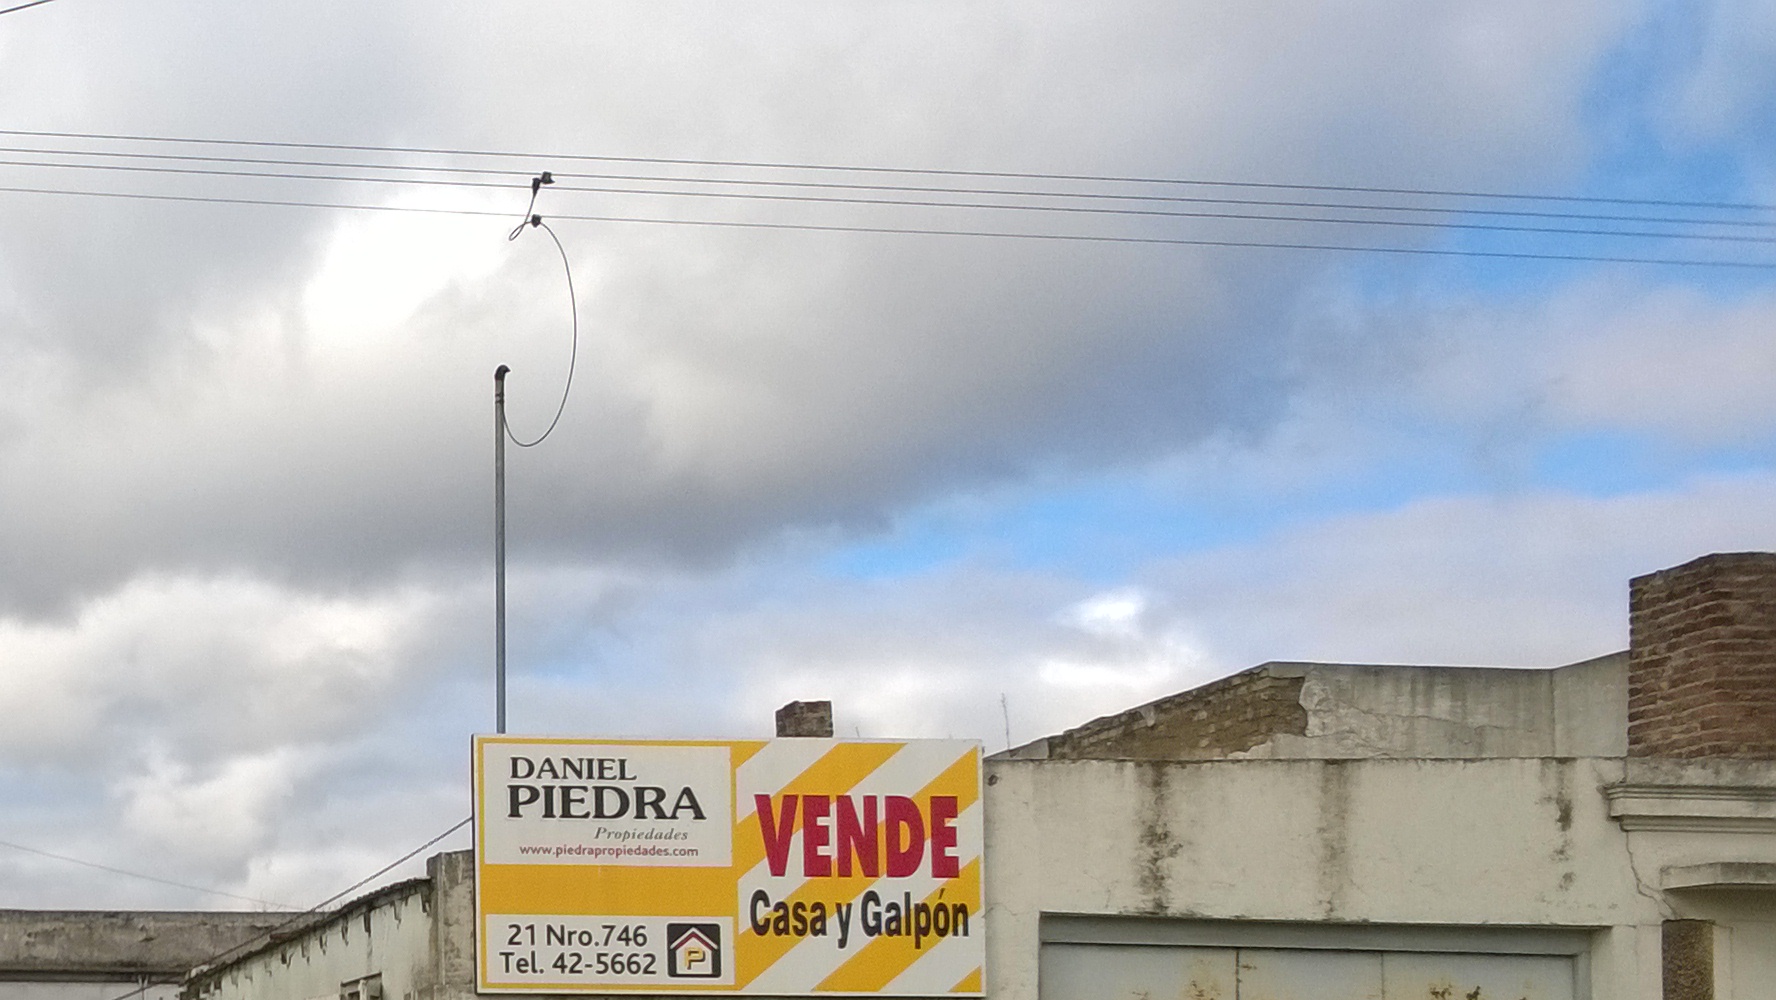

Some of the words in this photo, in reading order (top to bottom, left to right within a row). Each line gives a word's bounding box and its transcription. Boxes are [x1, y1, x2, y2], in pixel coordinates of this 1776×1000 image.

[510, 756, 637, 780] DANIEL
[507, 785, 707, 820] PIEDRA
[594, 827, 688, 842] Propiedades
[754, 794, 960, 878] VENDE
[519, 844, 699, 858] www.piedrapropiedades.com
[750, 889, 827, 936] Casa
[835, 902, 853, 949] y
[861, 888, 969, 949] Galpón
[507, 924, 535, 946] 21
[546, 924, 648, 947] Nro.746
[499, 951, 544, 974] Tel.
[552, 952, 657, 975] 42-5662
